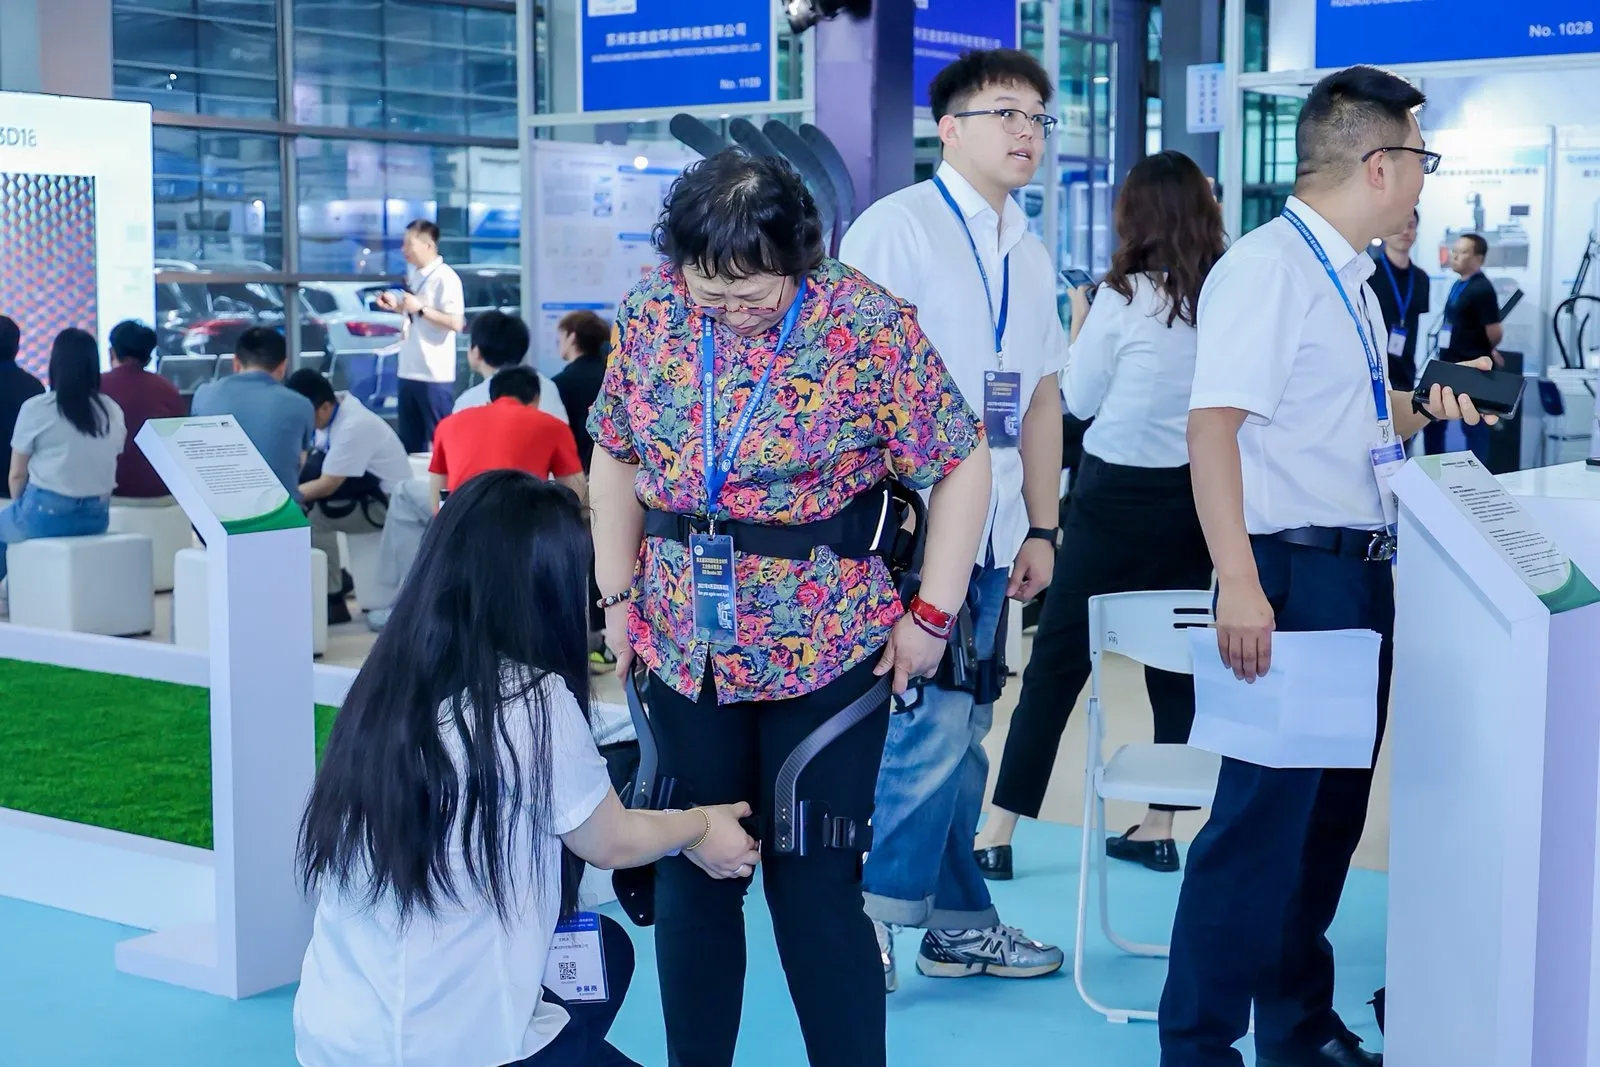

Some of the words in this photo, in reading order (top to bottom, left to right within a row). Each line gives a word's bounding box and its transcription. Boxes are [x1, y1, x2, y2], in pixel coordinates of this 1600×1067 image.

[1528, 23, 1556, 38] No.
[576, 985, 598, 993] 参展商
